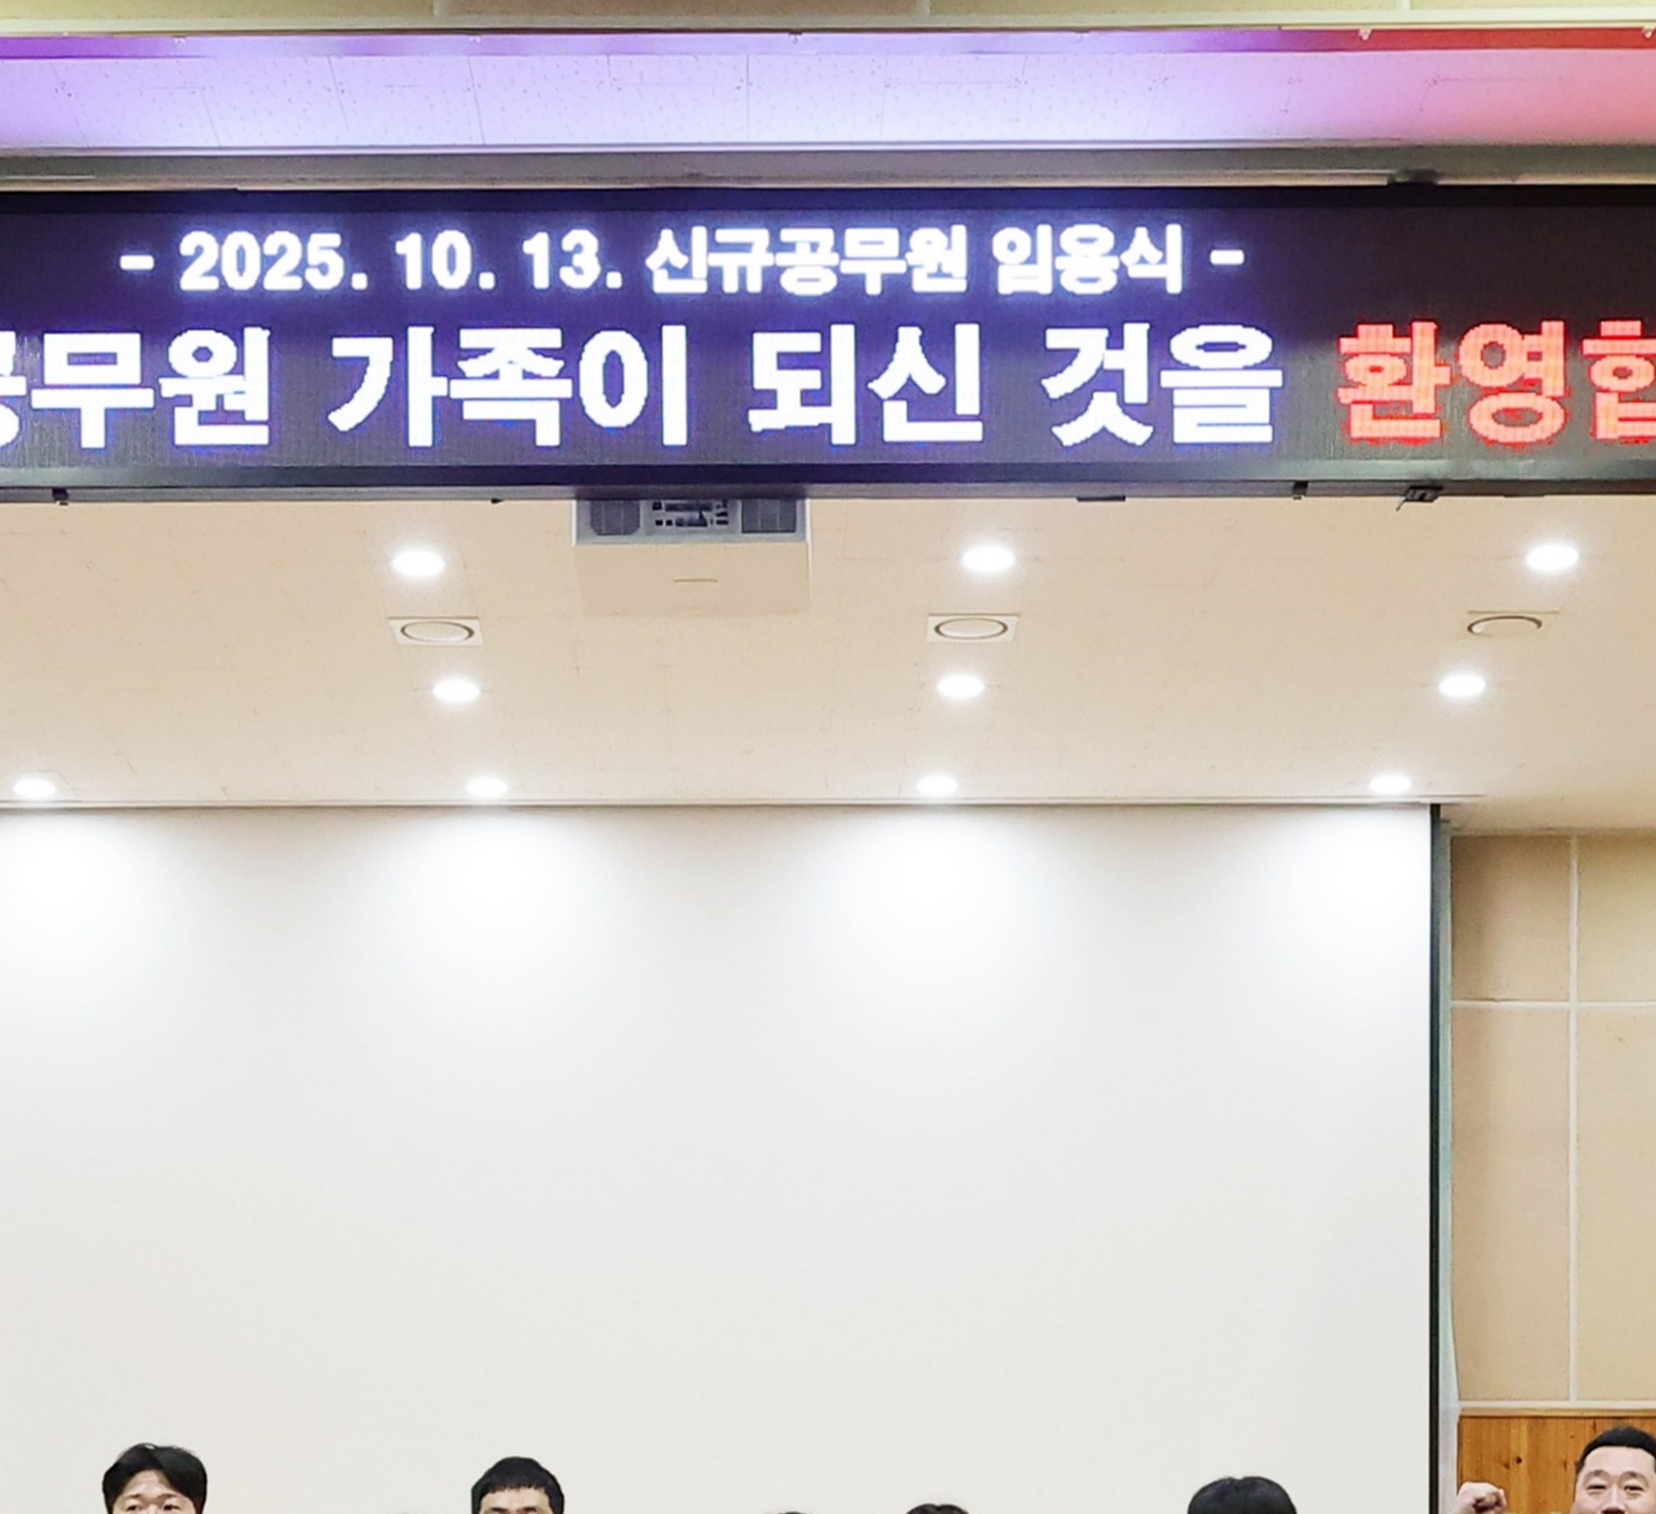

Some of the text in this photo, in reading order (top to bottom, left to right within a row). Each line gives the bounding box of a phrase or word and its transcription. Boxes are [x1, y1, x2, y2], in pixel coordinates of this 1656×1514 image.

[179, 230, 367, 291] 2025.
[395, 230, 495, 290] 10.
[522, 229, 622, 289] 13.
[645, 224, 968, 296] 신규공무원
[992, 223, 1183, 295] 임용식
[327, 325, 688, 447] 가족이
[748, 323, 983, 447] 되신
[1041, 323, 1283, 448] 것을
